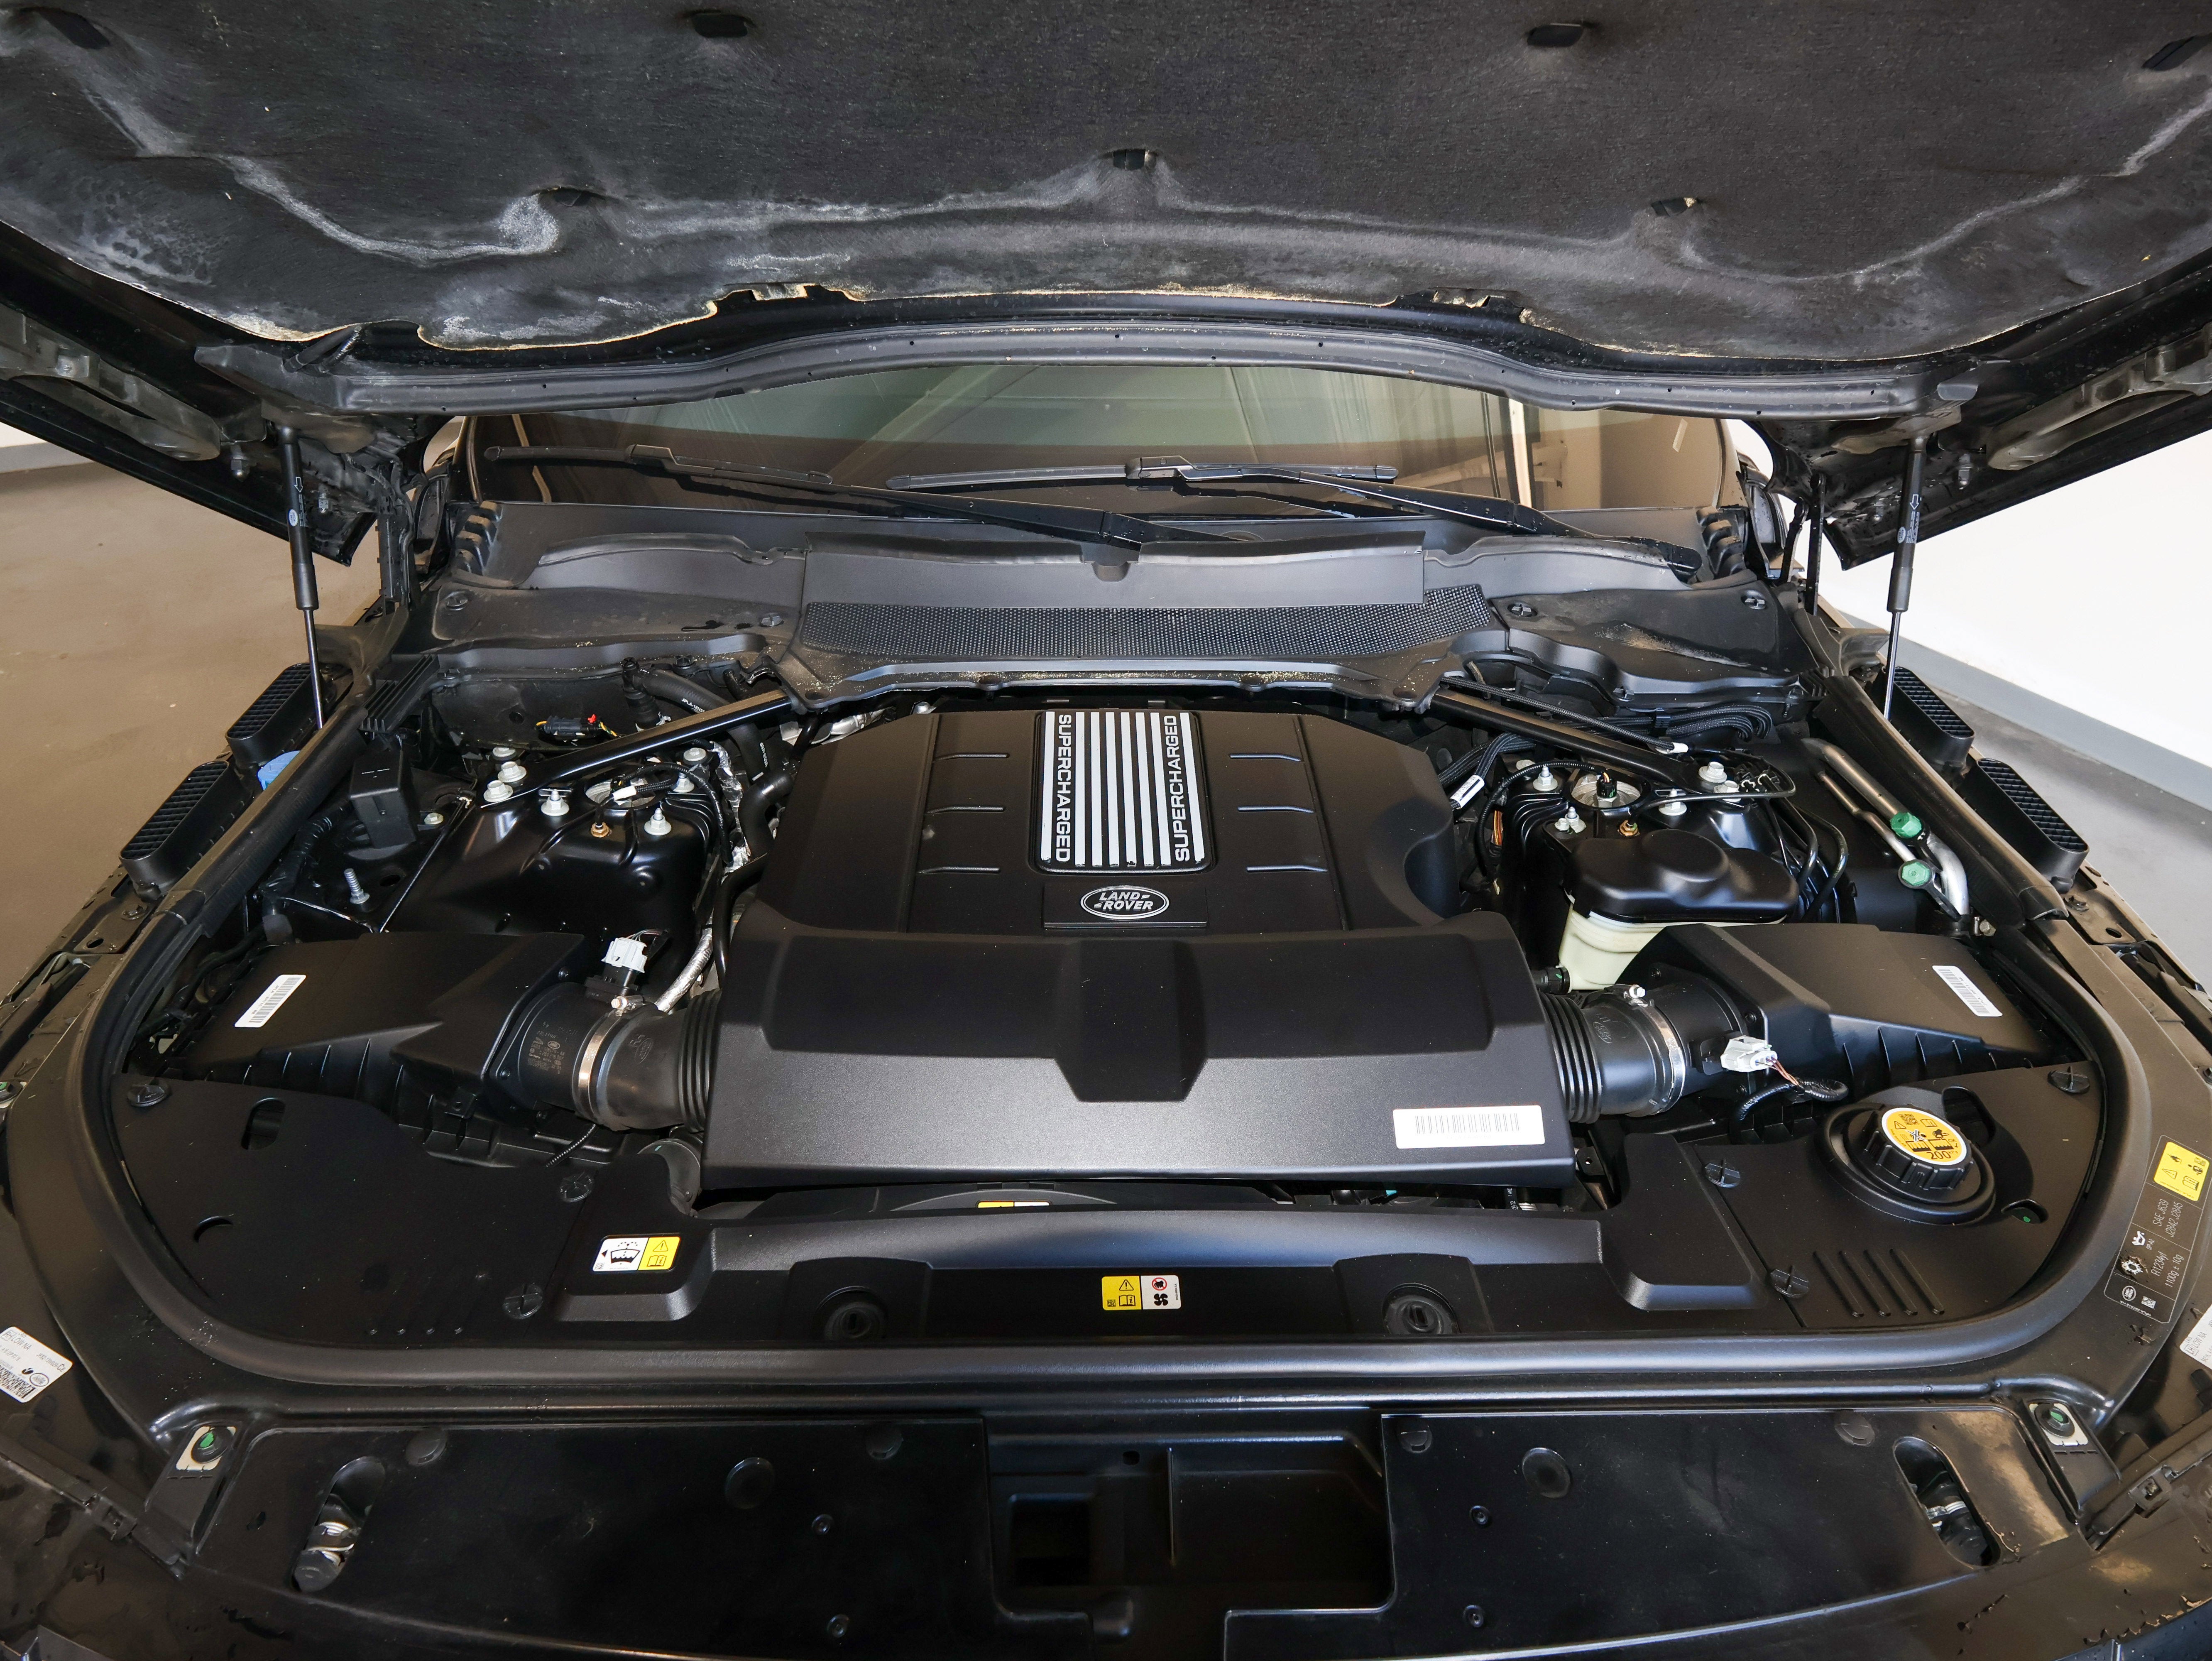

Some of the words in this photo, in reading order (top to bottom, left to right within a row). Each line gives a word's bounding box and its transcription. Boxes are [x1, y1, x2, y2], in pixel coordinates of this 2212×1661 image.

[1056, 714, 1071, 862] SUPERCHARGED
[1164, 715, 1189, 862] SUPERCHARGED
[1099, 892, 1140, 901] LAND
[1103, 901, 1153, 911] ROVER
[1927, 1151, 1951, 1159] 200
[2157, 1199, 2169, 1214] J639
[2170, 1201, 2183, 1220] J2845
[2152, 1212, 2165, 1227] SAE
[2165, 1218, 2178, 1237] J2842
[2151, 1251, 2168, 1276] R1234yf
[11, 1336, 25, 1346] LOW
[2192, 1337, 2203, 1348] LOW
